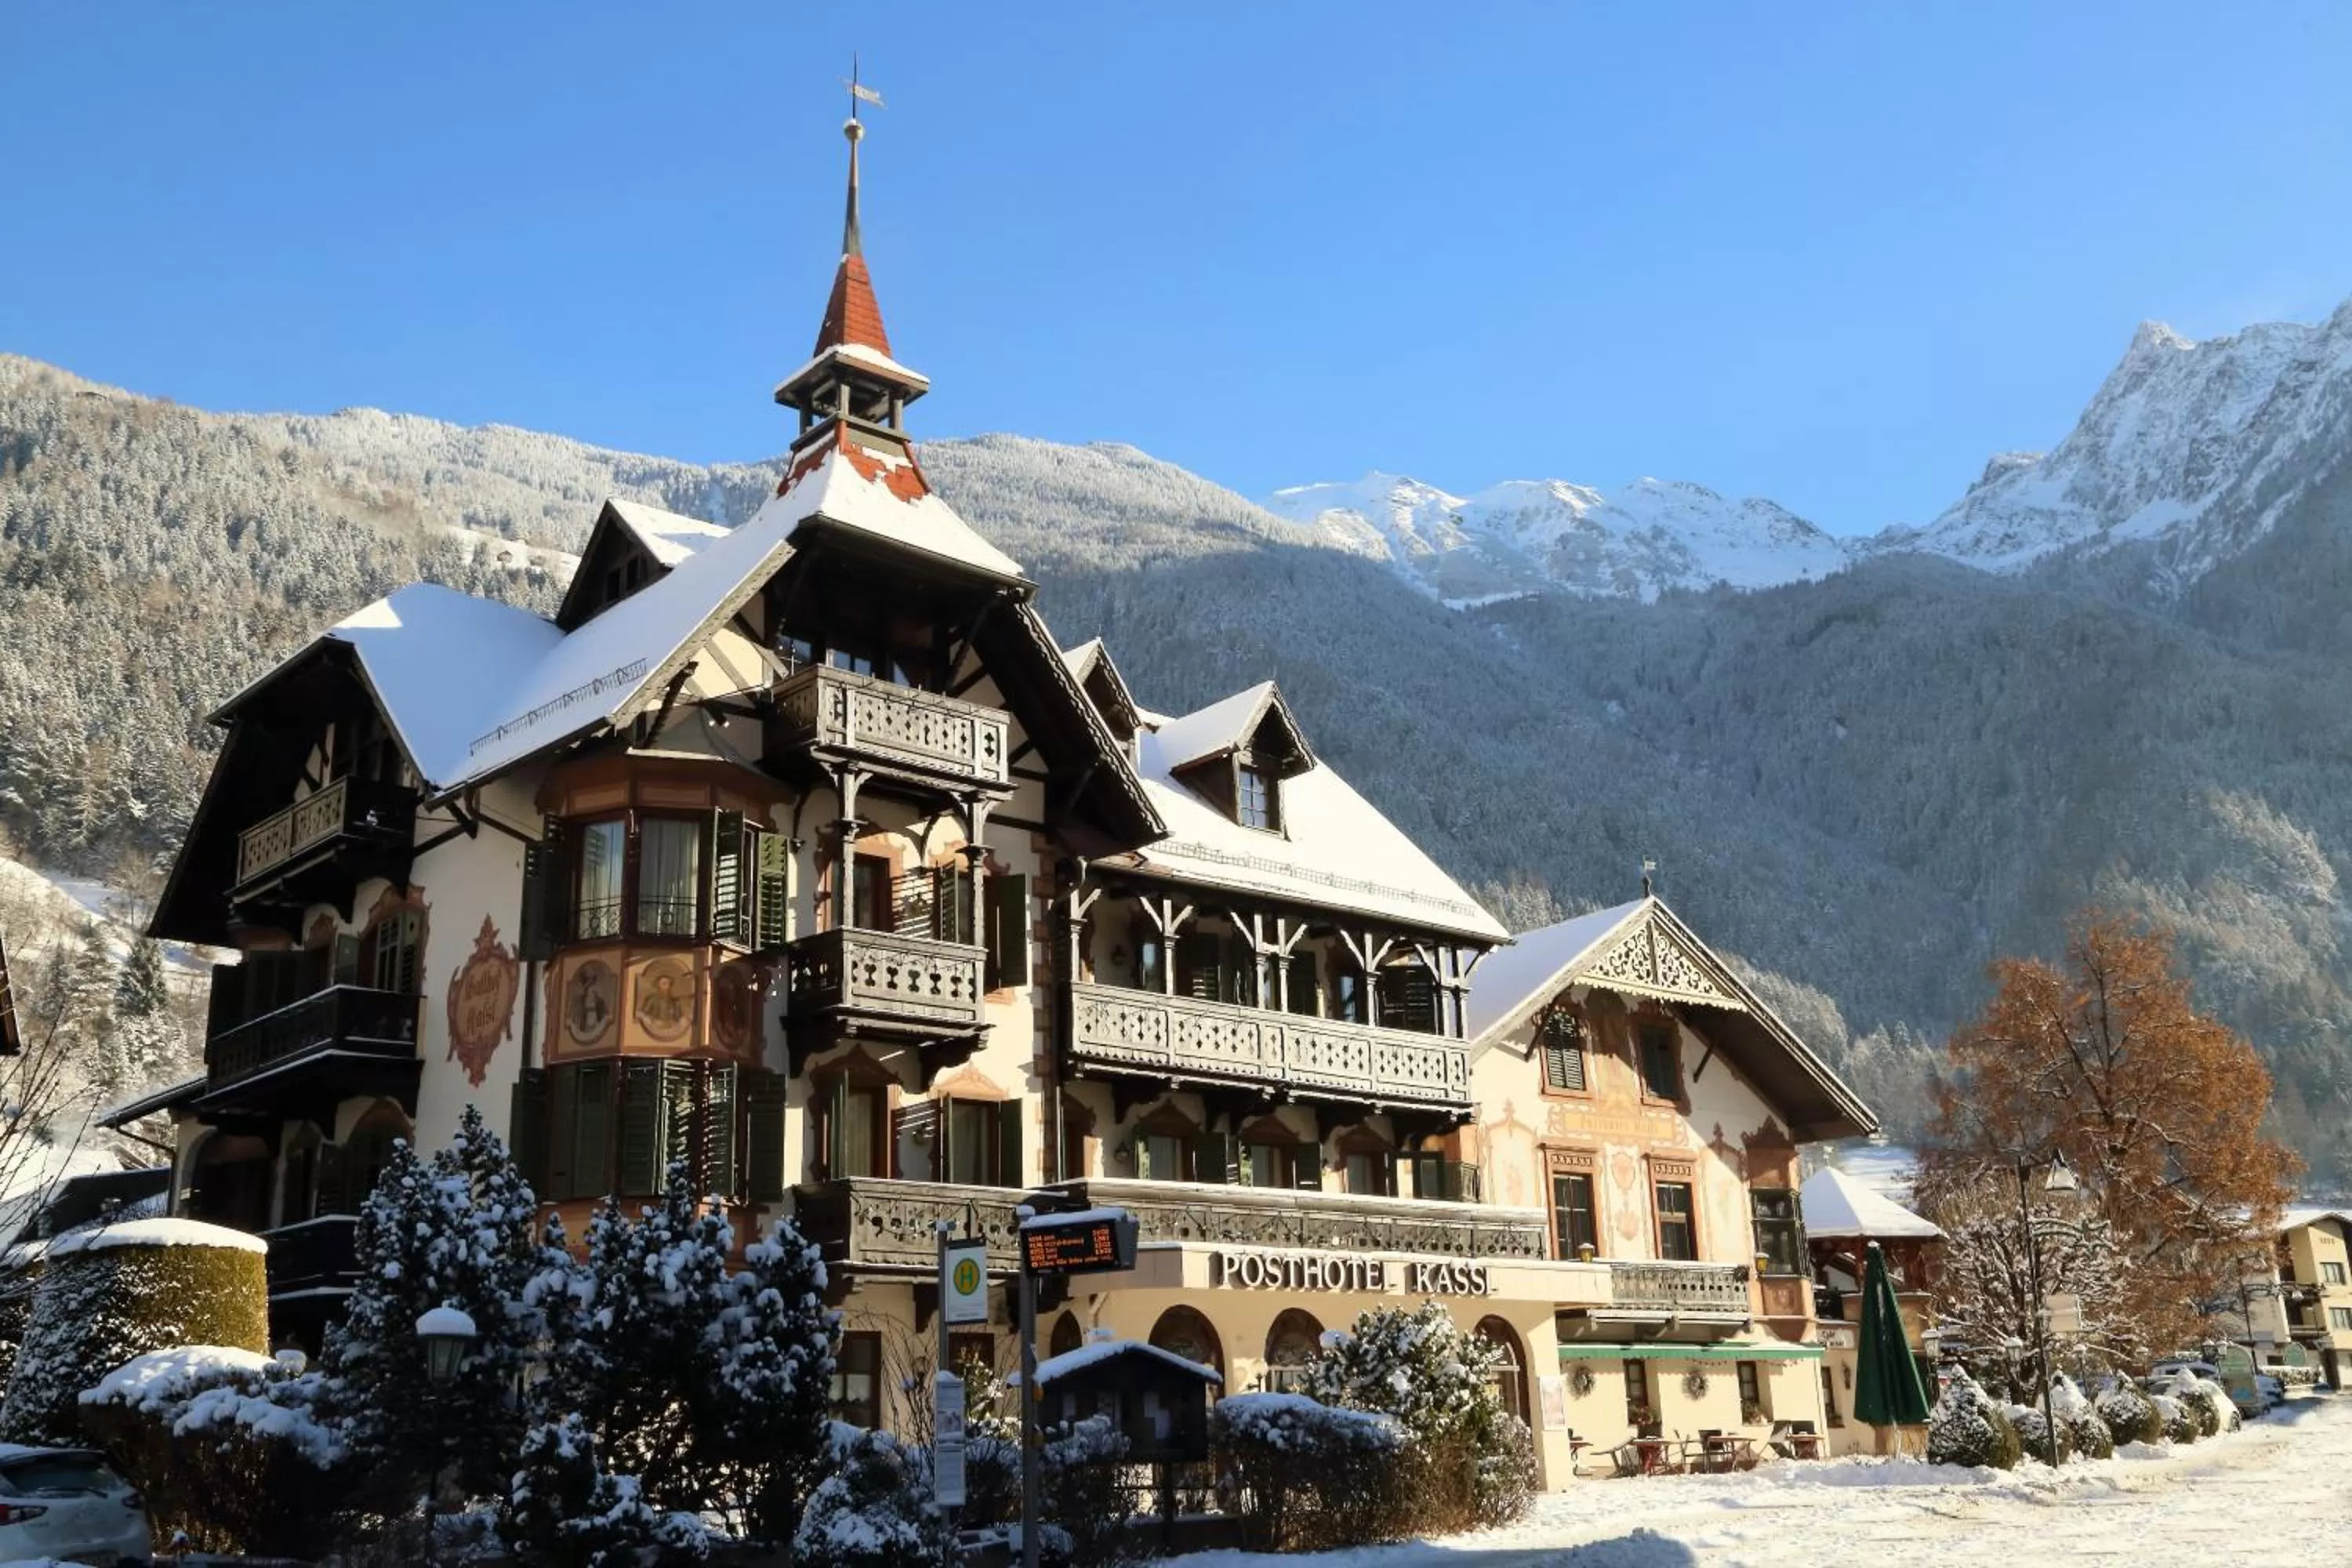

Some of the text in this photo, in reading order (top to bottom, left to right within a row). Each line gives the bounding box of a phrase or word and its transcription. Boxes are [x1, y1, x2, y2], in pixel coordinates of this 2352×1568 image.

[960, 1265, 974, 1289] H
[1221, 1254, 1494, 1295] POSTHOTEL KASSL
